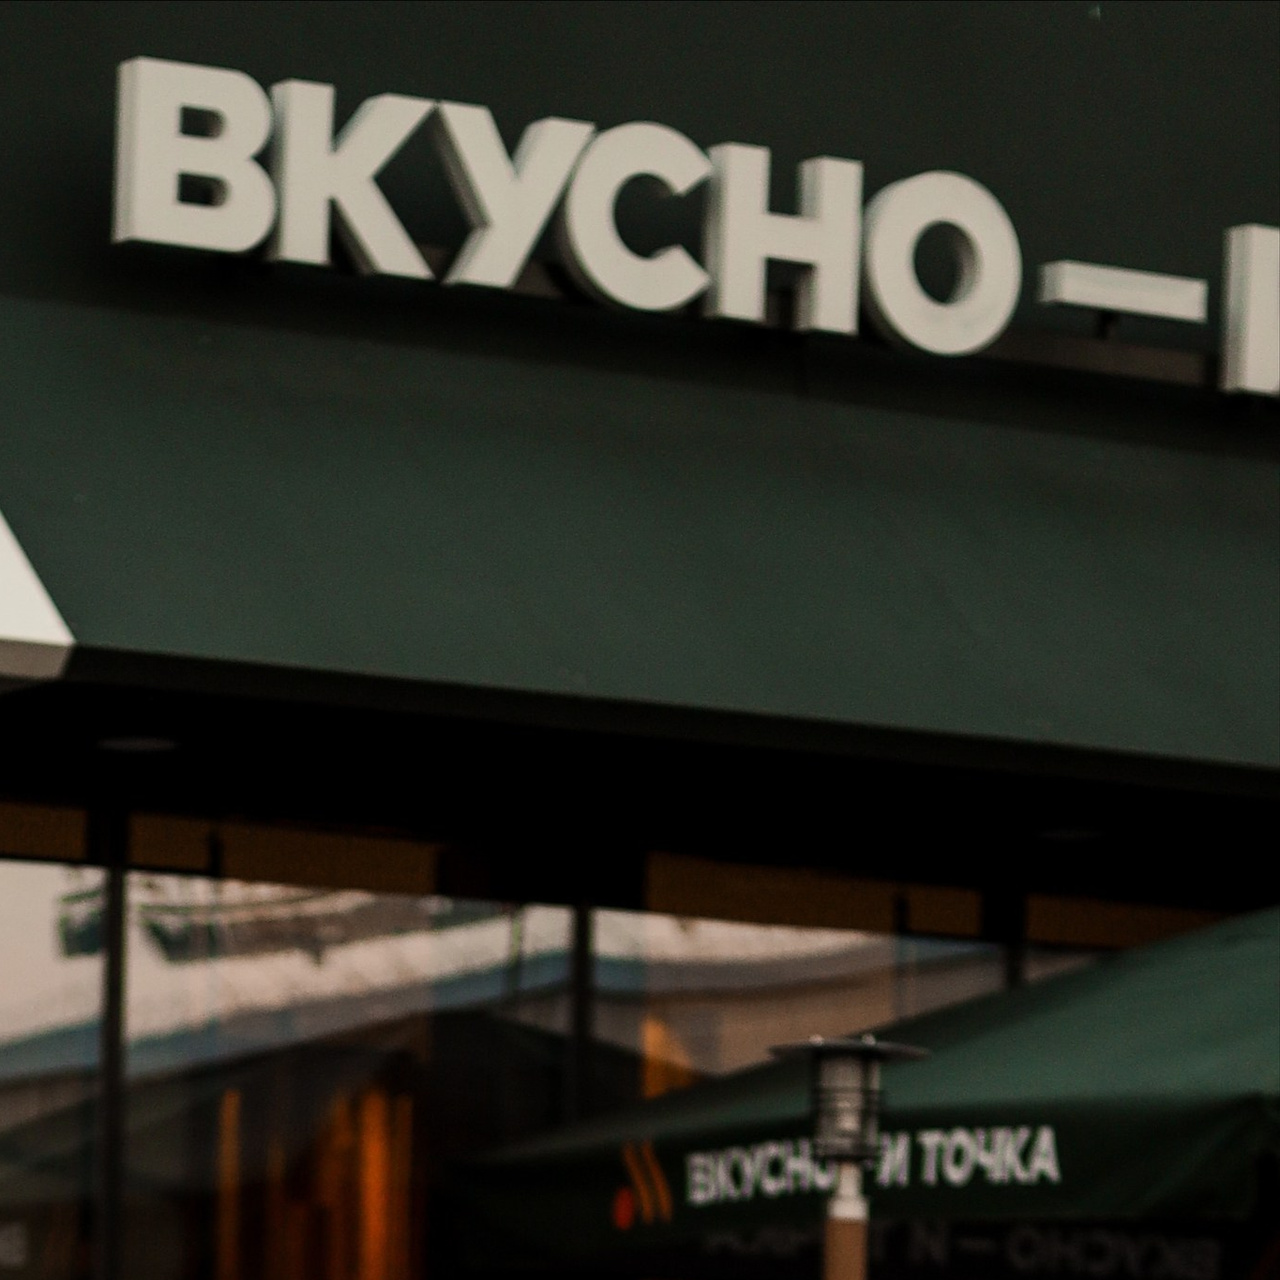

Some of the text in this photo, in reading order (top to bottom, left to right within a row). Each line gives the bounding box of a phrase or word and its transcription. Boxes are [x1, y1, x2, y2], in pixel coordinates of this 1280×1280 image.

[113, 57, 1023, 357] ВКУСНО
[876, 1131, 910, 1188] И
[917, 1124, 1062, 1187] ТОЧКА
